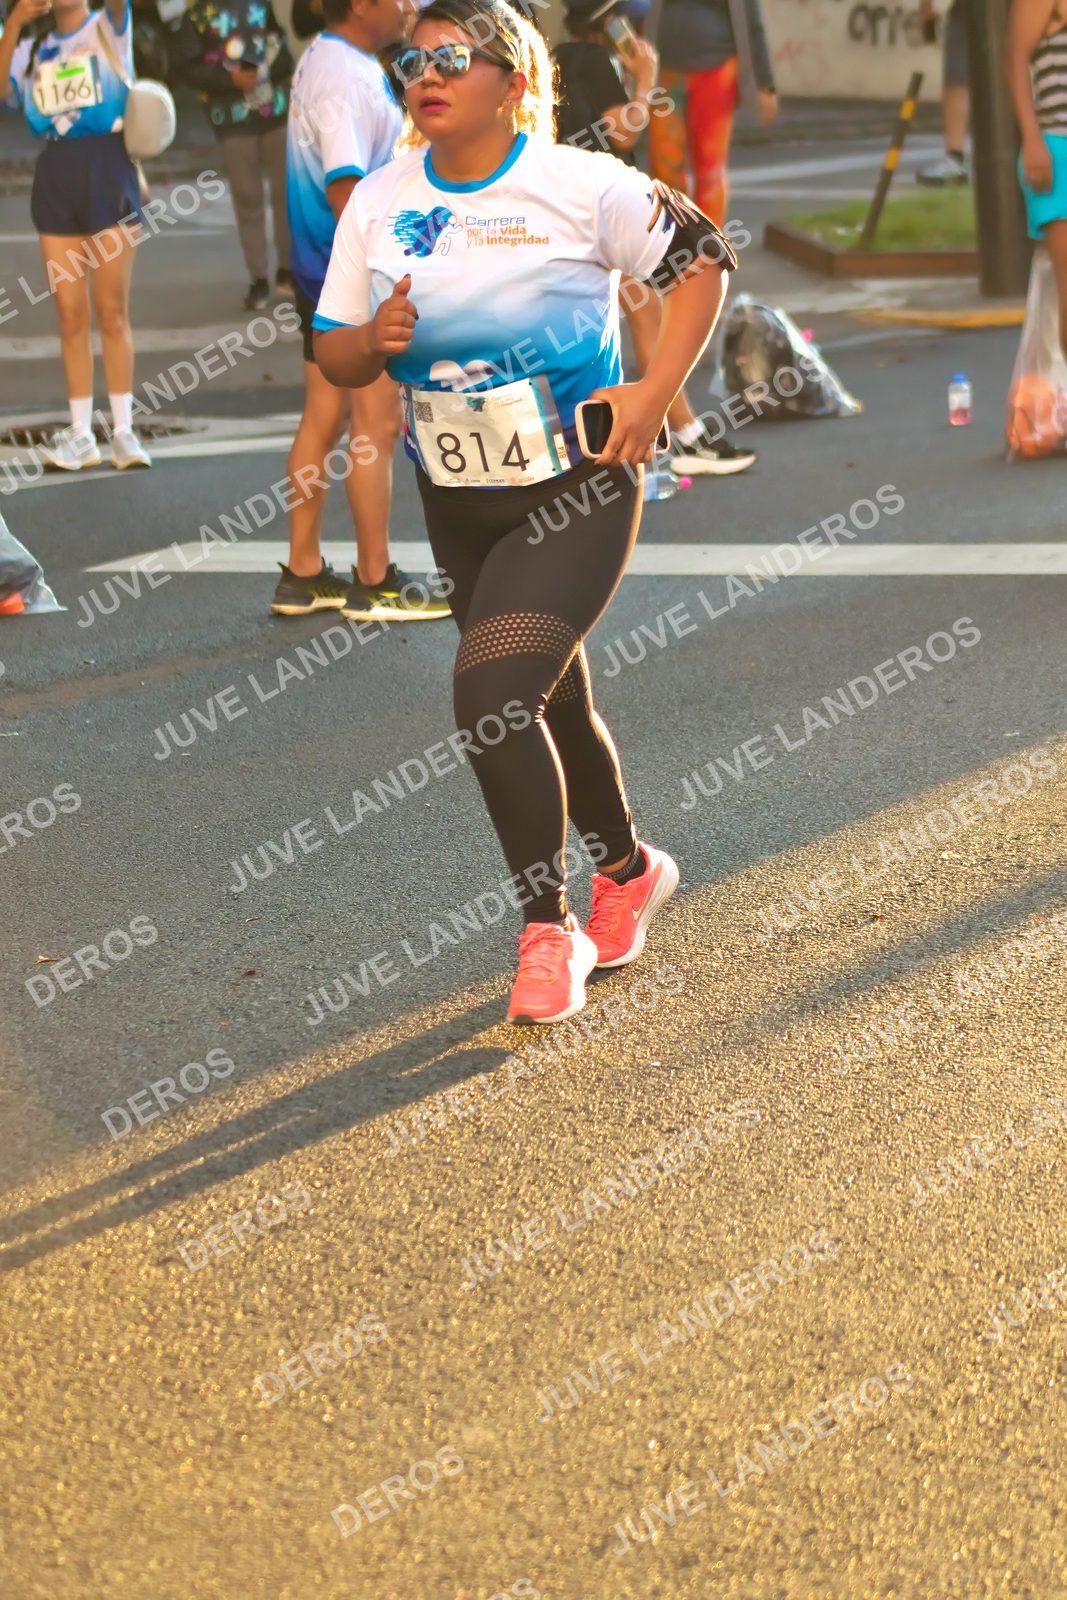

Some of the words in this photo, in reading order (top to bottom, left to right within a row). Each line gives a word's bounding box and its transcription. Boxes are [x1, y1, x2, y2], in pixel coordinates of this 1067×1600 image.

[38, 77, 91, 109] 1166
[465, 216, 526, 227] Carrera
[467, 228, 483, 238] por
[467, 239, 473, 248] y
[475, 237, 484, 246] la
[436, 430, 530, 473] 814
